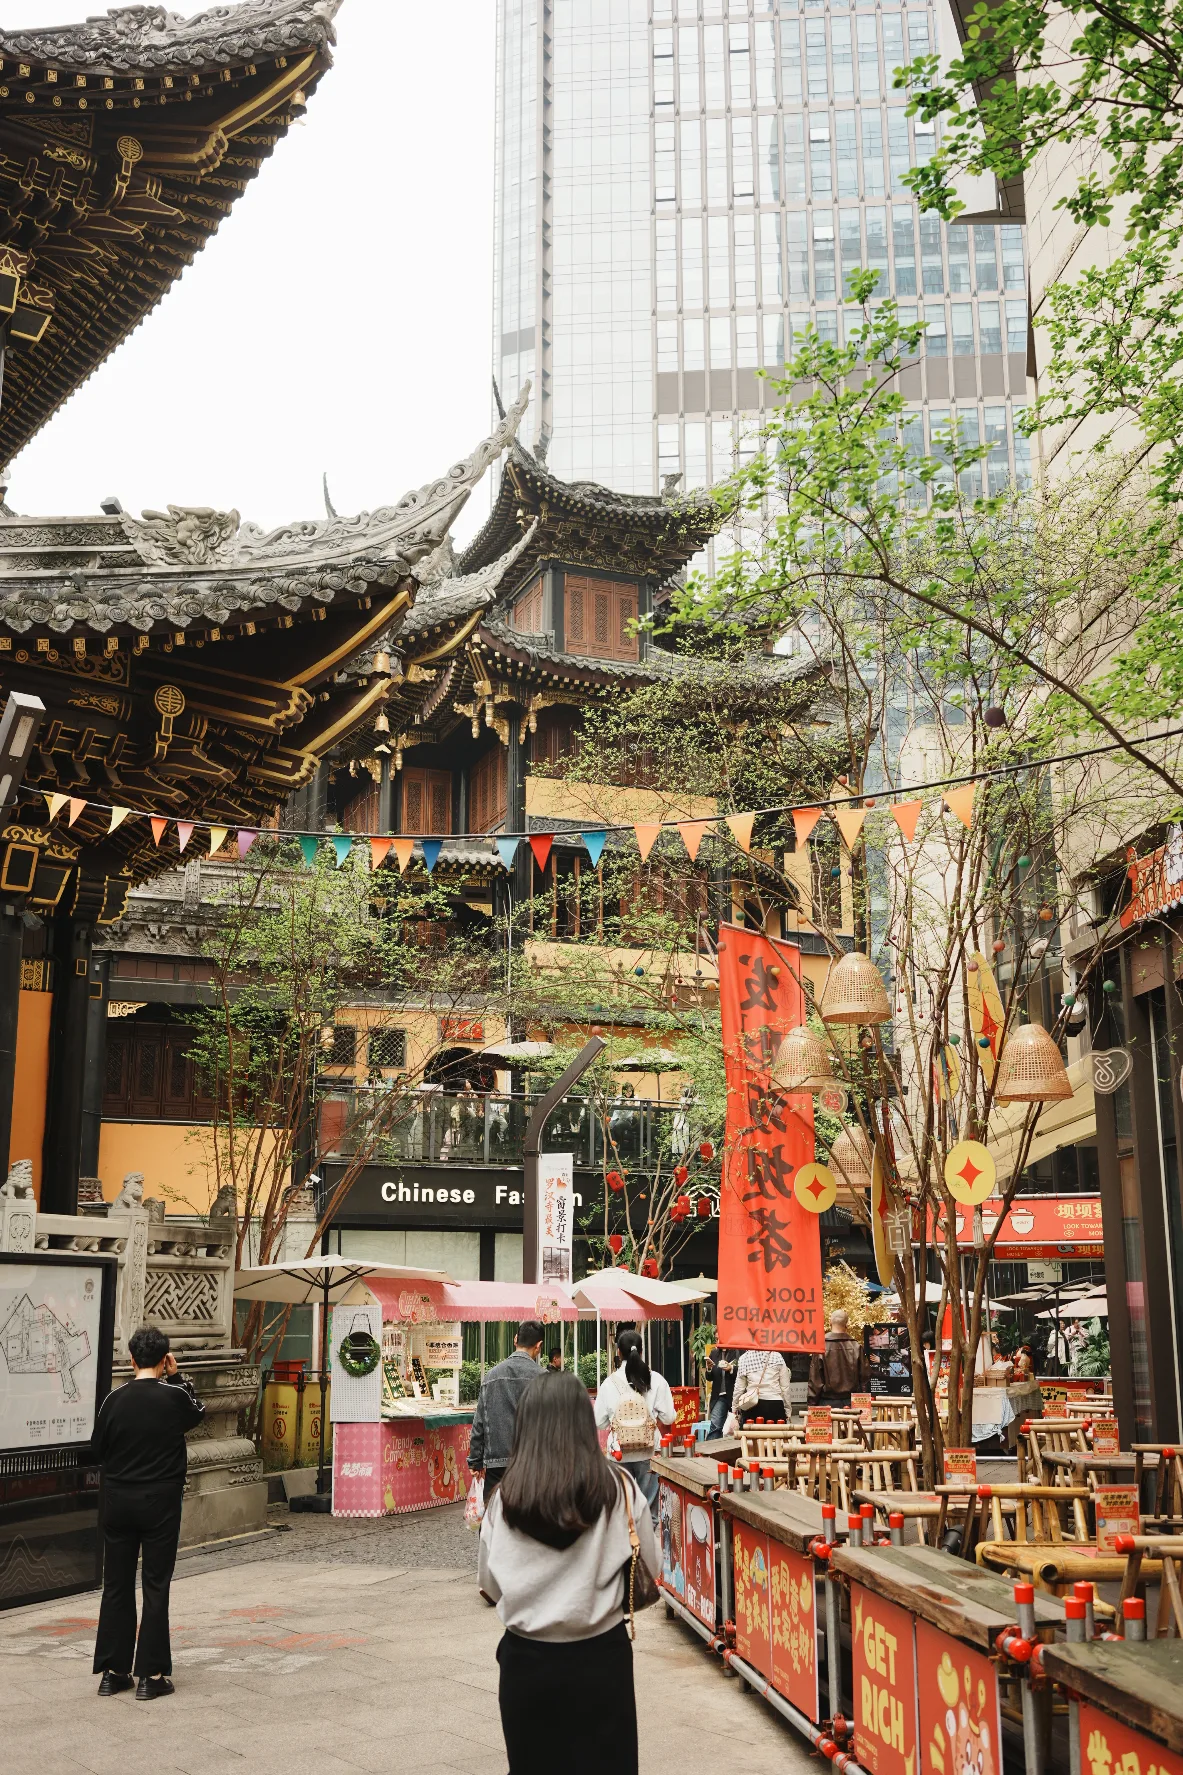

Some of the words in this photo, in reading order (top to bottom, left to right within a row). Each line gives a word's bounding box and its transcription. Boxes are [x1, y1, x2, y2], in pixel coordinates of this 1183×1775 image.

[381, 1182, 475, 1204] Chinese
[545, 1178, 555, 1238] 罗汉寺最美
[863, 1616, 897, 1686] GET
[861, 1674, 905, 1755] RICH
